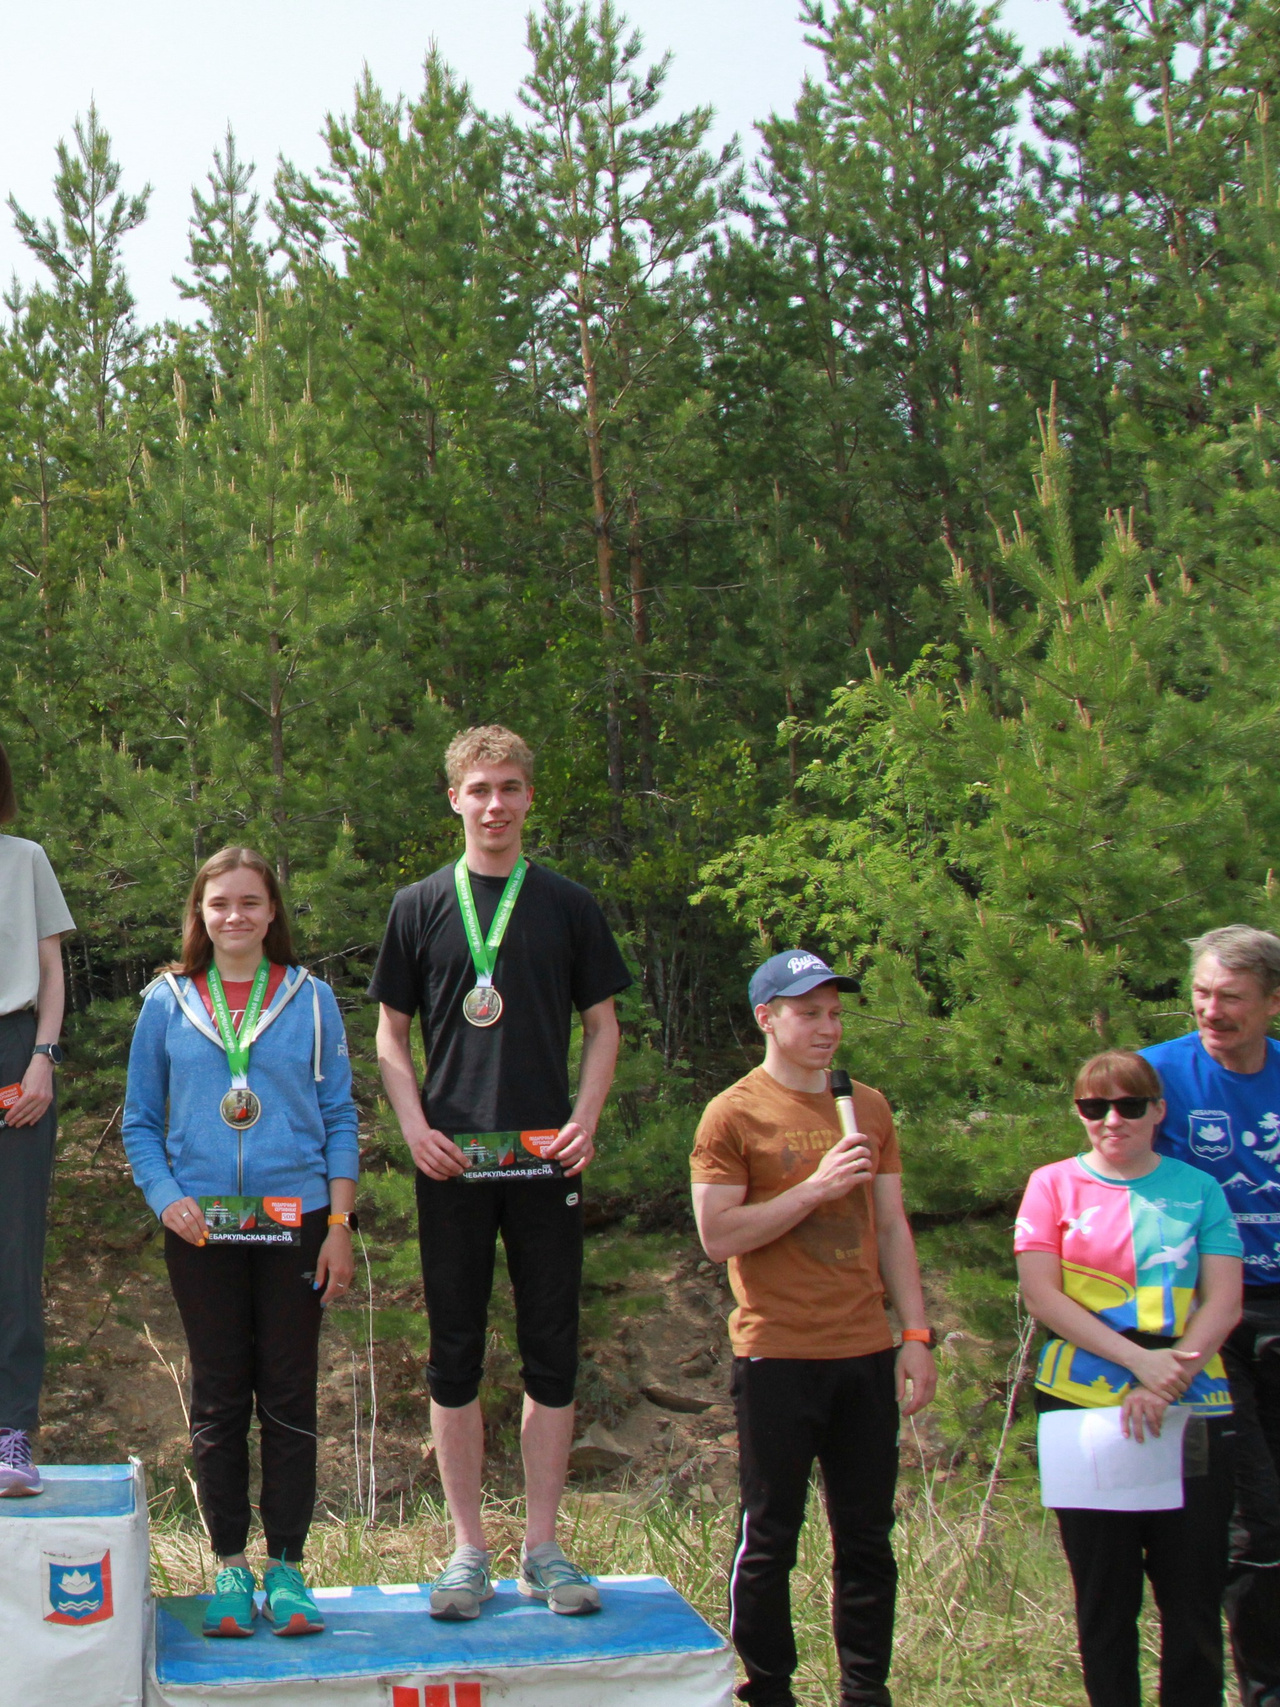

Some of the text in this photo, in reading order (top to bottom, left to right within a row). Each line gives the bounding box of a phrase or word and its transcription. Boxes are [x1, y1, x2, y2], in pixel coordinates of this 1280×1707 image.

[212, 982, 221, 1002] ВЕСНА
[463, 1168, 554, 1179] ЧЕБАРКУЛЬСКАЯ ВЕСНА
[207, 1233, 293, 1242] ЕБАРКУЛЬСКАЯ ВЕСНА
